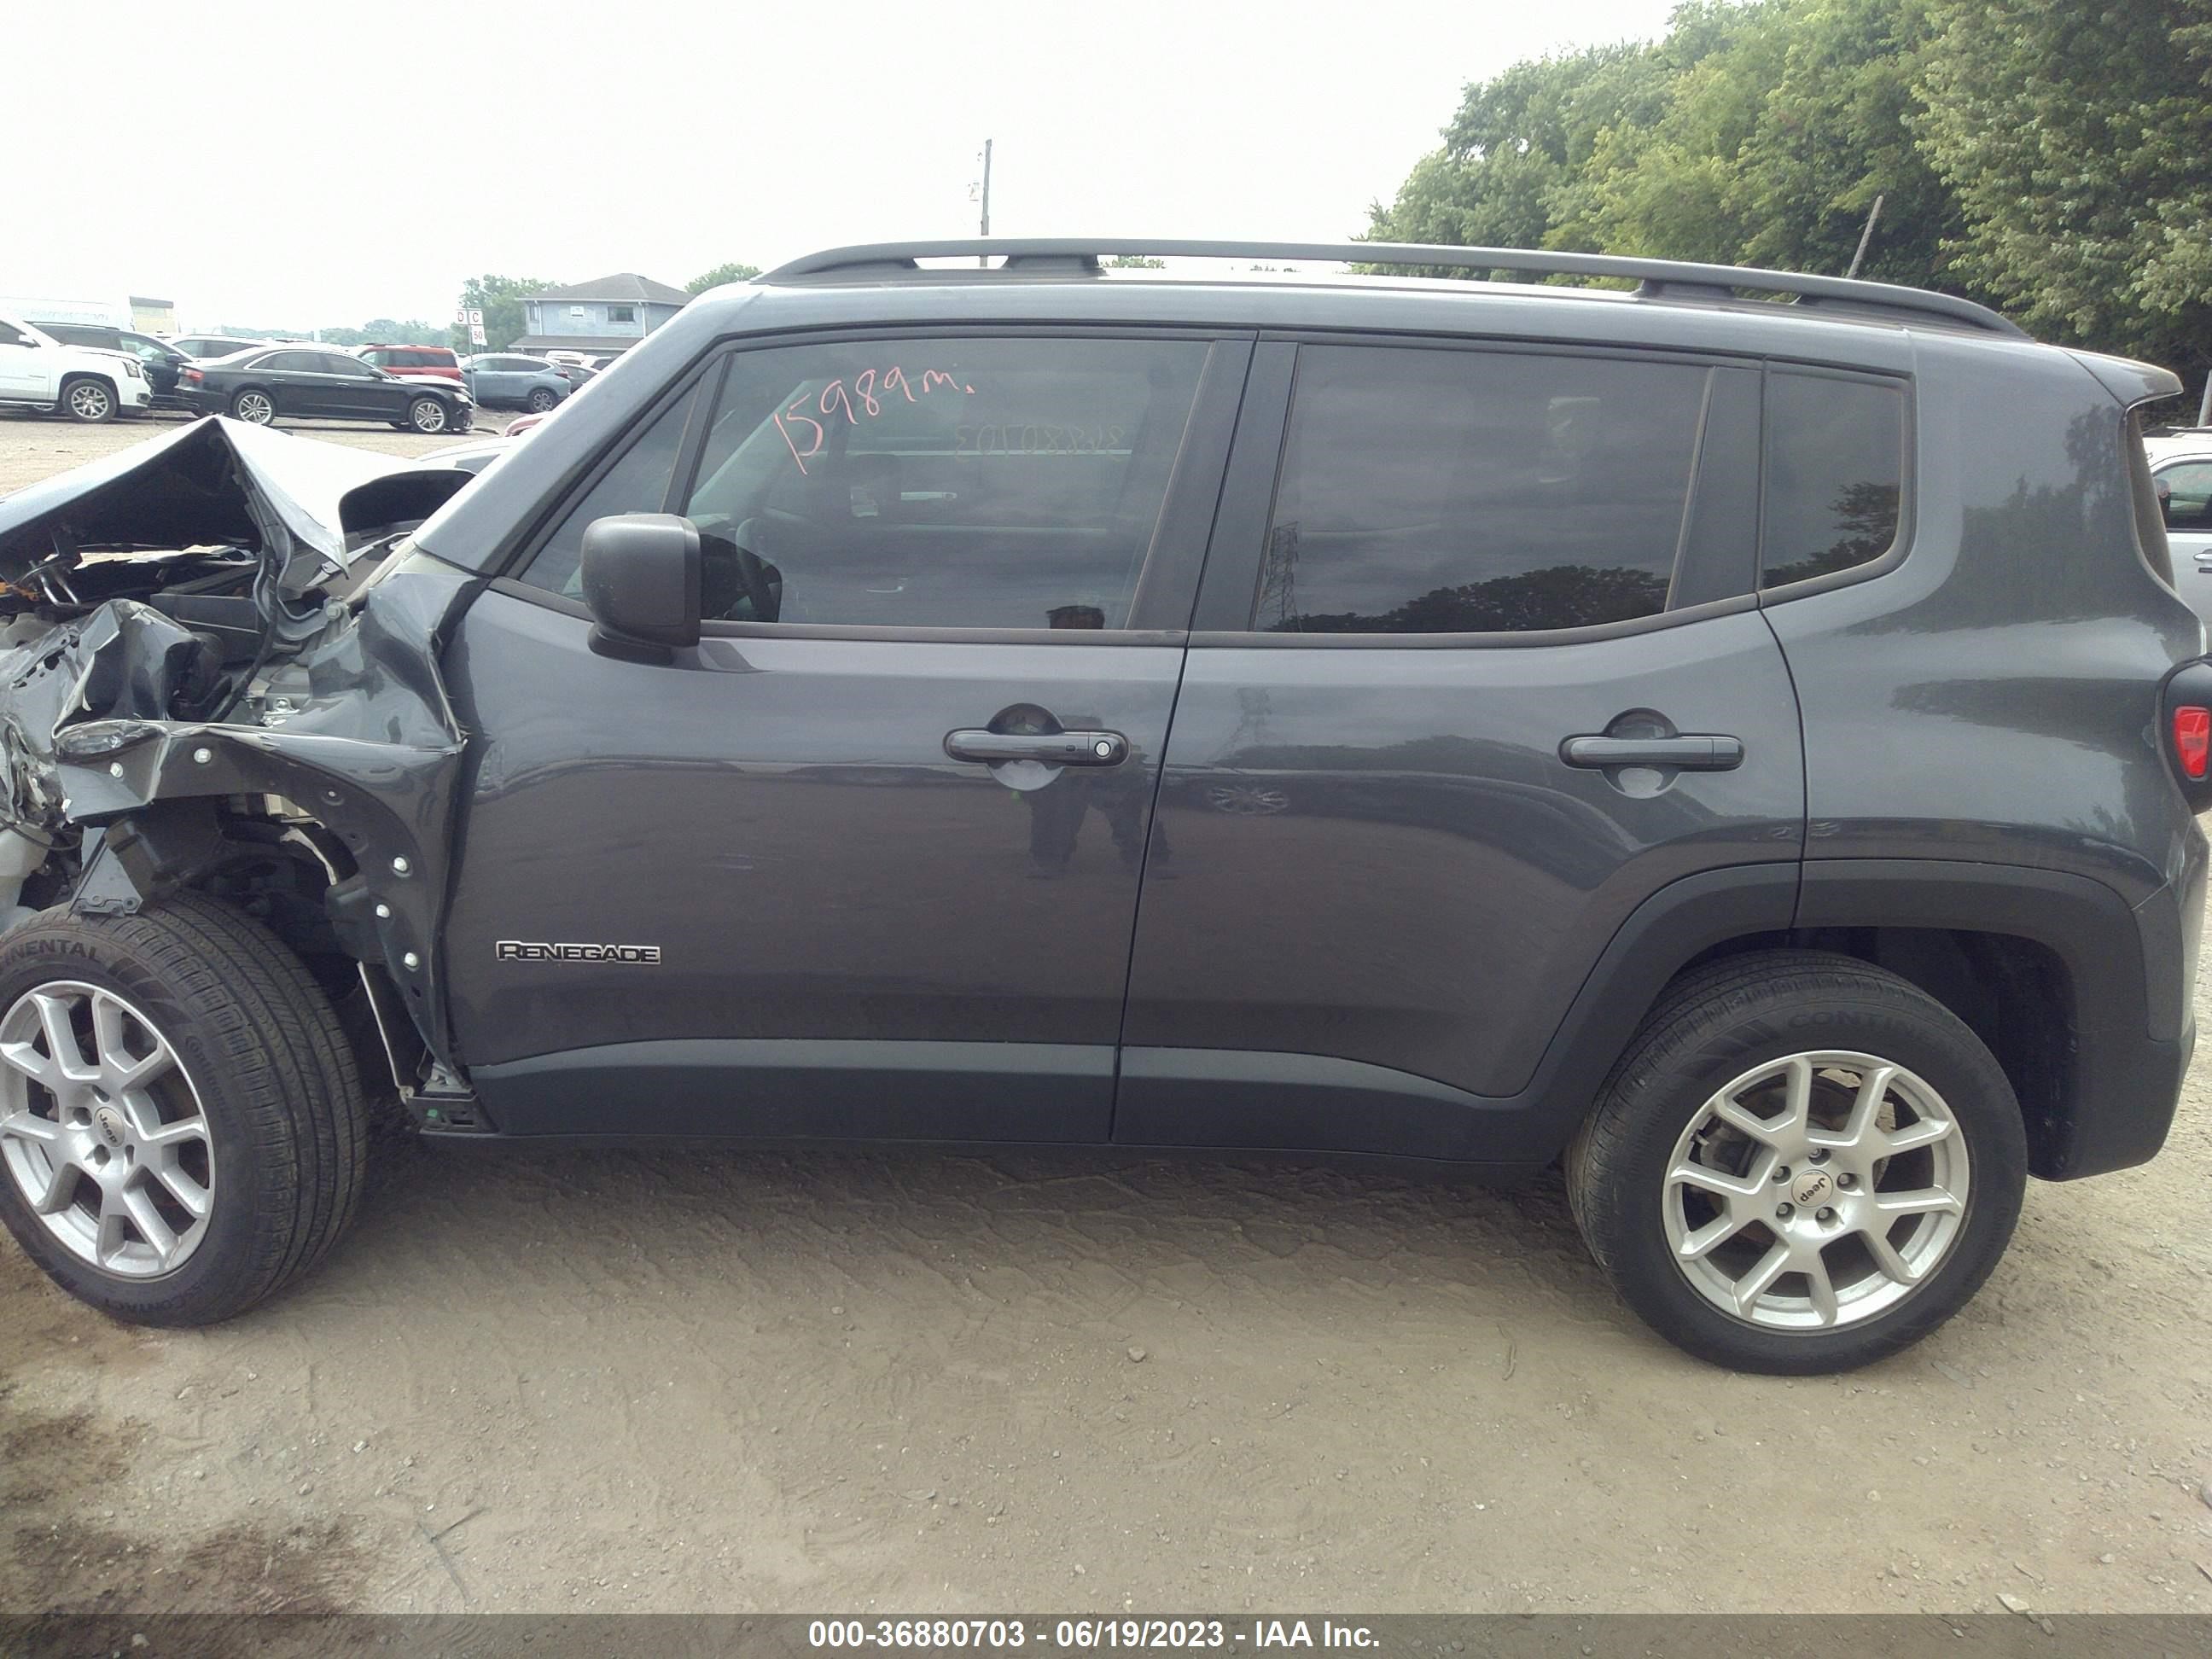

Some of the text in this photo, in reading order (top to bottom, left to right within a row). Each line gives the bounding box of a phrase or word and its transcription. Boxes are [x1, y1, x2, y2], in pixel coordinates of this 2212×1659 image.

[457, 311, 464, 323] D
[472, 311, 480, 323] C
[496, 940, 661, 965] RENEGADE
[99, 1113, 118, 1144] Jeep
[1800, 1177, 1826, 1202] Jeep
